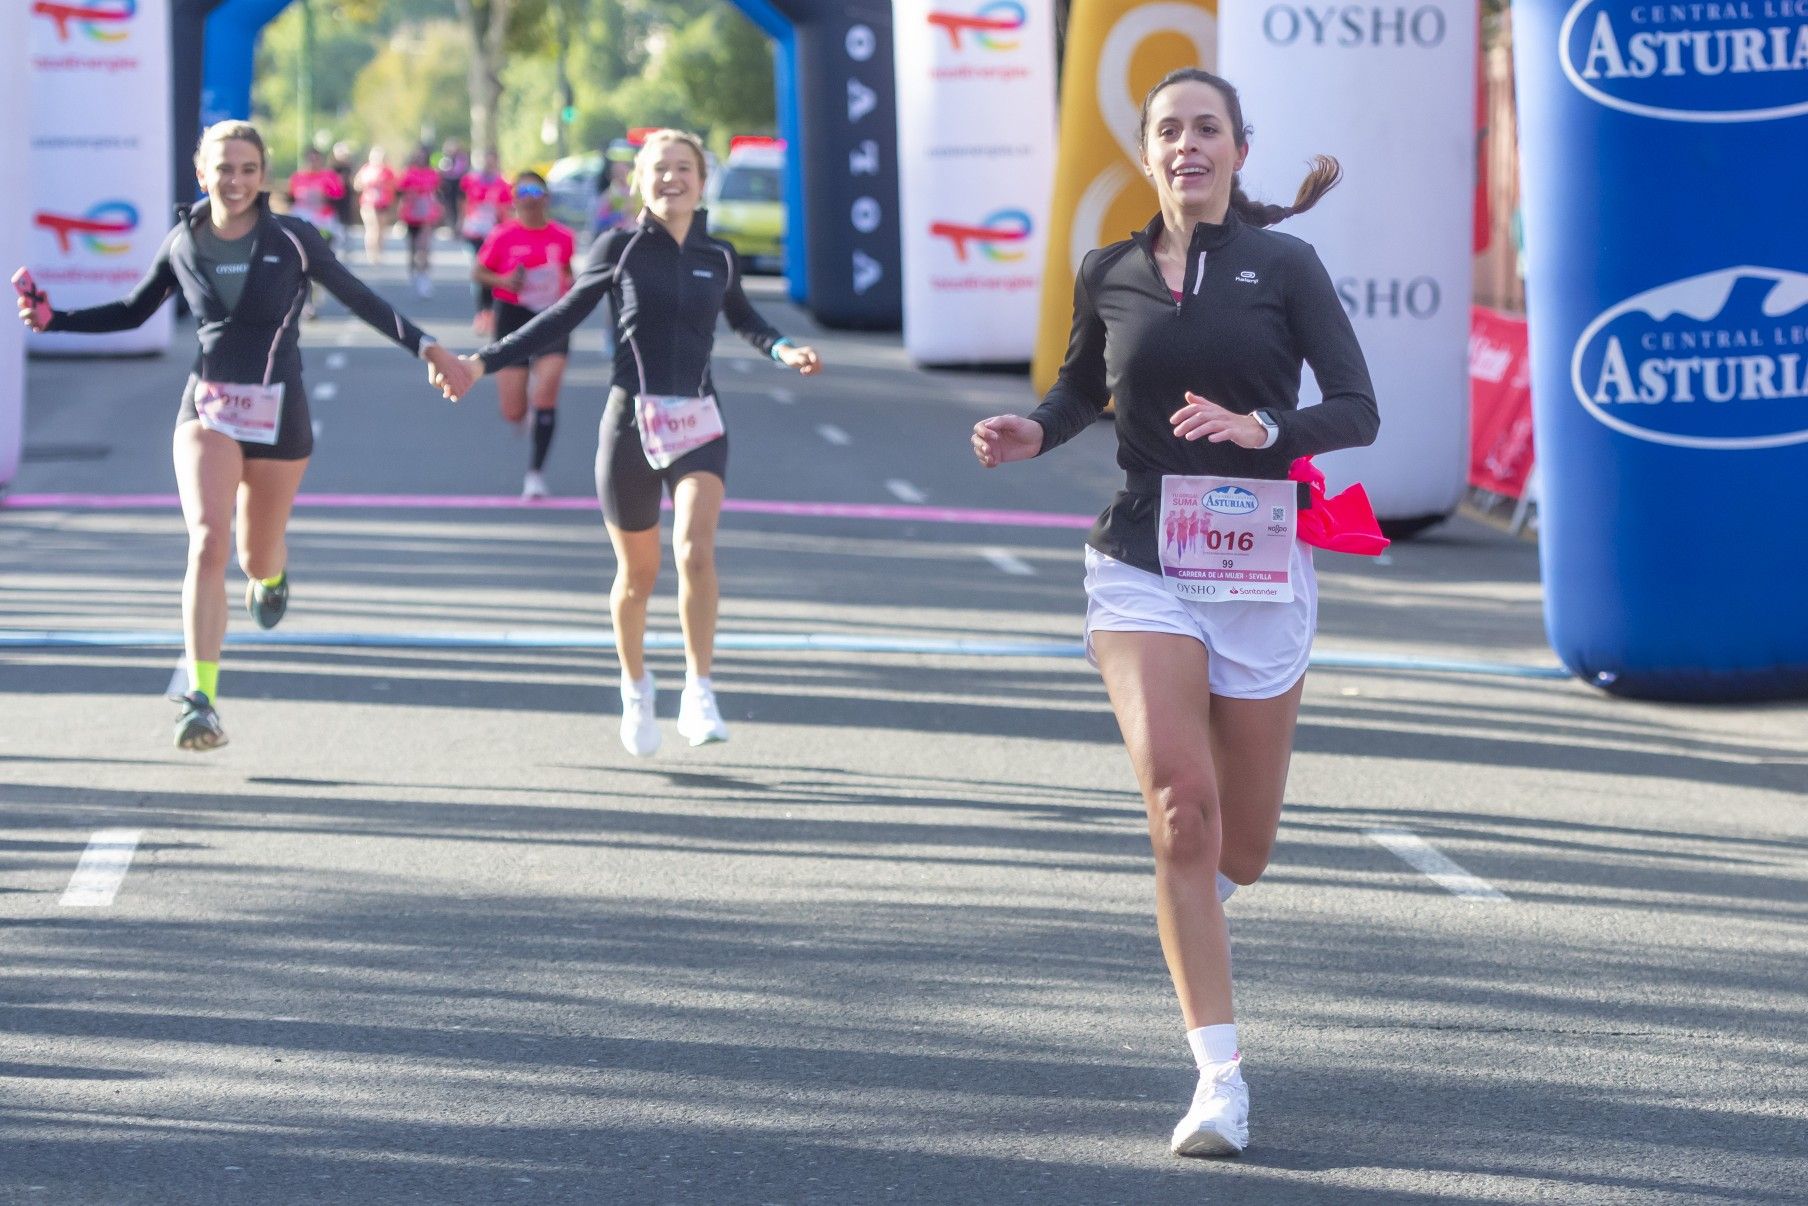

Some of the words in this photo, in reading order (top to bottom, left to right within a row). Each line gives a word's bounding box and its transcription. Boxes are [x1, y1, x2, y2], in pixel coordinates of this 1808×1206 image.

[1631, 1, 1754, 24] CENTRAL
[1262, 4, 1447, 48] OYSHO
[845, 23, 884, 297] VOLVO
[1336, 275, 1441, 320] SHO
[1641, 329, 1764, 351] CENTRAL
[1773, 325, 1808, 345] LE
[1594, 335, 1808, 404] ASTURI
[1172, 498, 1198, 506] SUMA
[1206, 530, 1254, 551] 016
[1178, 570, 1206, 579] CARRERA
[1225, 572, 1244, 580] MUJER
[1222, 559, 1234, 569] 99
[1177, 583, 1216, 595] OYSHO
[1239, 588, 1278, 596] Santander
